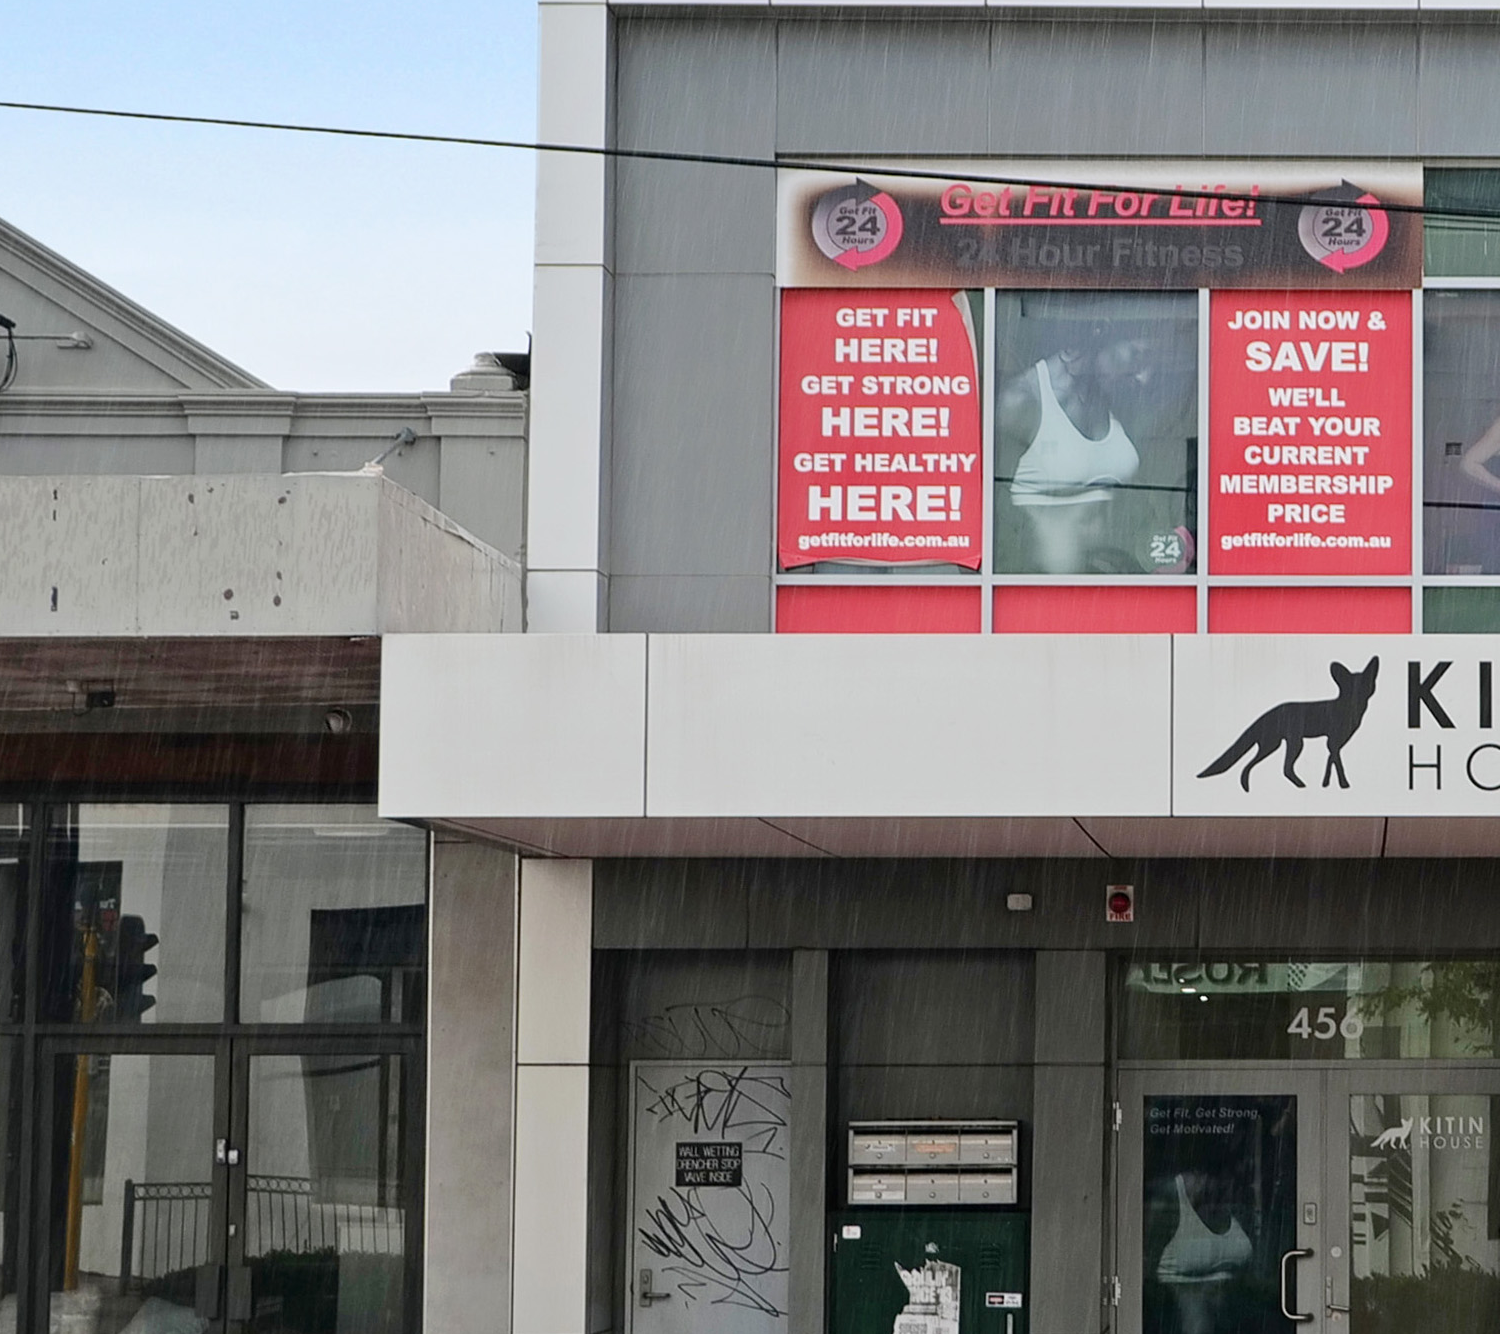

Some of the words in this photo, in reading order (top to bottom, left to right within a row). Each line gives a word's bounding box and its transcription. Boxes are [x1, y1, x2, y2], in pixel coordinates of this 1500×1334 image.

[941, 183, 1013, 216] Get
[1023, 184, 1078, 216] Fit
[1088, 184, 1158, 217] For
[1169, 184, 1259, 217] Life!
[839, 206, 860, 216] Get
[860, 206, 877, 216] Fit
[835, 216, 880, 236] 24
[1321, 217, 1366, 237] 24
[842, 236, 875, 245] Hours
[1328, 237, 1361, 247] Hours
[1012, 237, 1101, 267] Hour
[1112, 238, 1244, 268] Fitness
[836, 308, 888, 327] GET
[897, 308, 938, 327] FIT
[1228, 310, 1291, 330] JOIN
[1299, 310, 1360, 330] NOW
[1367, 311, 1387, 331] &
[835, 338, 938, 363] HERE!
[1245, 341, 1369, 372] SAVE!
[801, 375, 854, 395] GET
[862, 375, 971, 395] STRONG
[1268, 387, 1346, 407] WE'LL
[821, 407, 950, 437] HERE!
[1233, 417, 1301, 436] BEAT
[1308, 417, 1381, 436] YOUR
[793, 453, 847, 472] GET
[854, 453, 977, 472] HEALTHY
[1244, 446, 1369, 465] CURRENT
[1220, 474, 1393, 494] MEMBERSHIP
[808, 485, 962, 521] HERE!
[1268, 504, 1346, 523] PRICE
[798, 532, 970, 550] getfitforlife.com.au
[1150, 541, 1181, 557] 24
[1221, 532, 1392, 550] getfitforlife.com.au
[1287, 1007, 1364, 1039] 456
[1173, 1123, 1235, 1134] Motivated!
[1420, 1116, 1483, 1134] KITIN
[678, 1146, 700, 1157] WALL
[703, 1146, 740, 1157] WETTING
[1420, 1136, 1483, 1149] HOUSE
[676, 1158, 719, 1170] DRENCHER
[720, 1158, 742, 1170] STOP
[684, 1171, 706, 1183] VALVE
[708, 1171, 733, 1183] INSIDE
